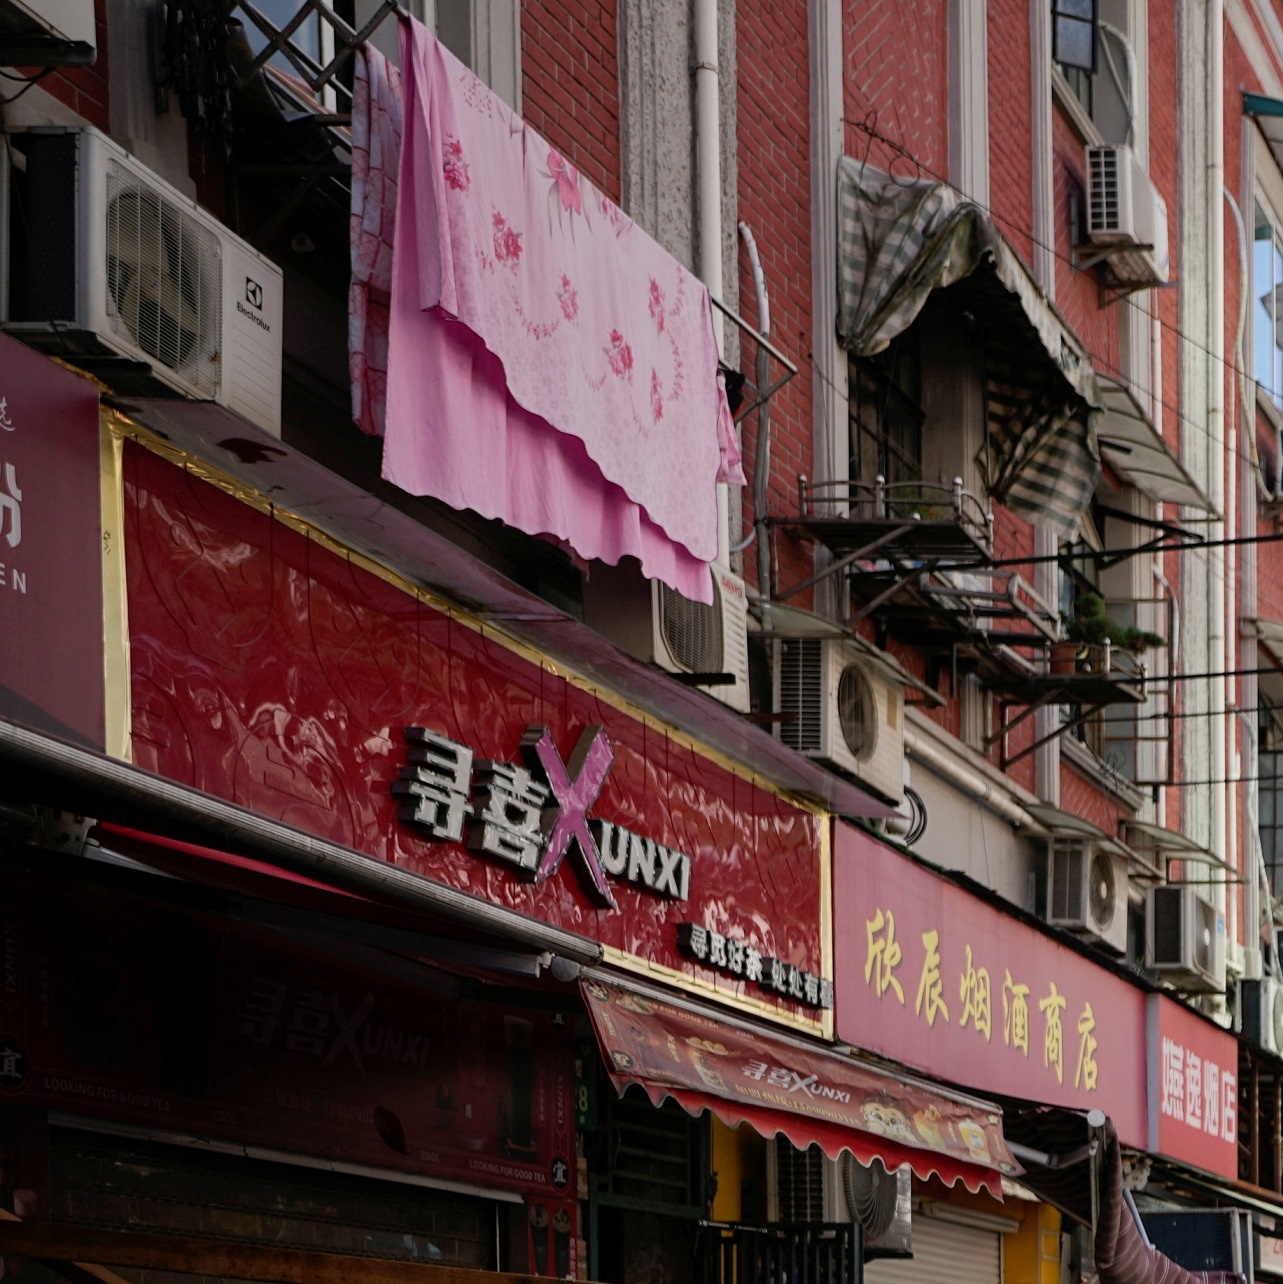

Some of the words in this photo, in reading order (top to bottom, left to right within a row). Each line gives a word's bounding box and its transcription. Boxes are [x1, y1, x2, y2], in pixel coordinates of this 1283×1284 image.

[236, 300, 271, 333] Electrolux
[721, 575, 743, 598] SANYO
[863, 907, 1100, 1092] 欣辰烟酒商店
